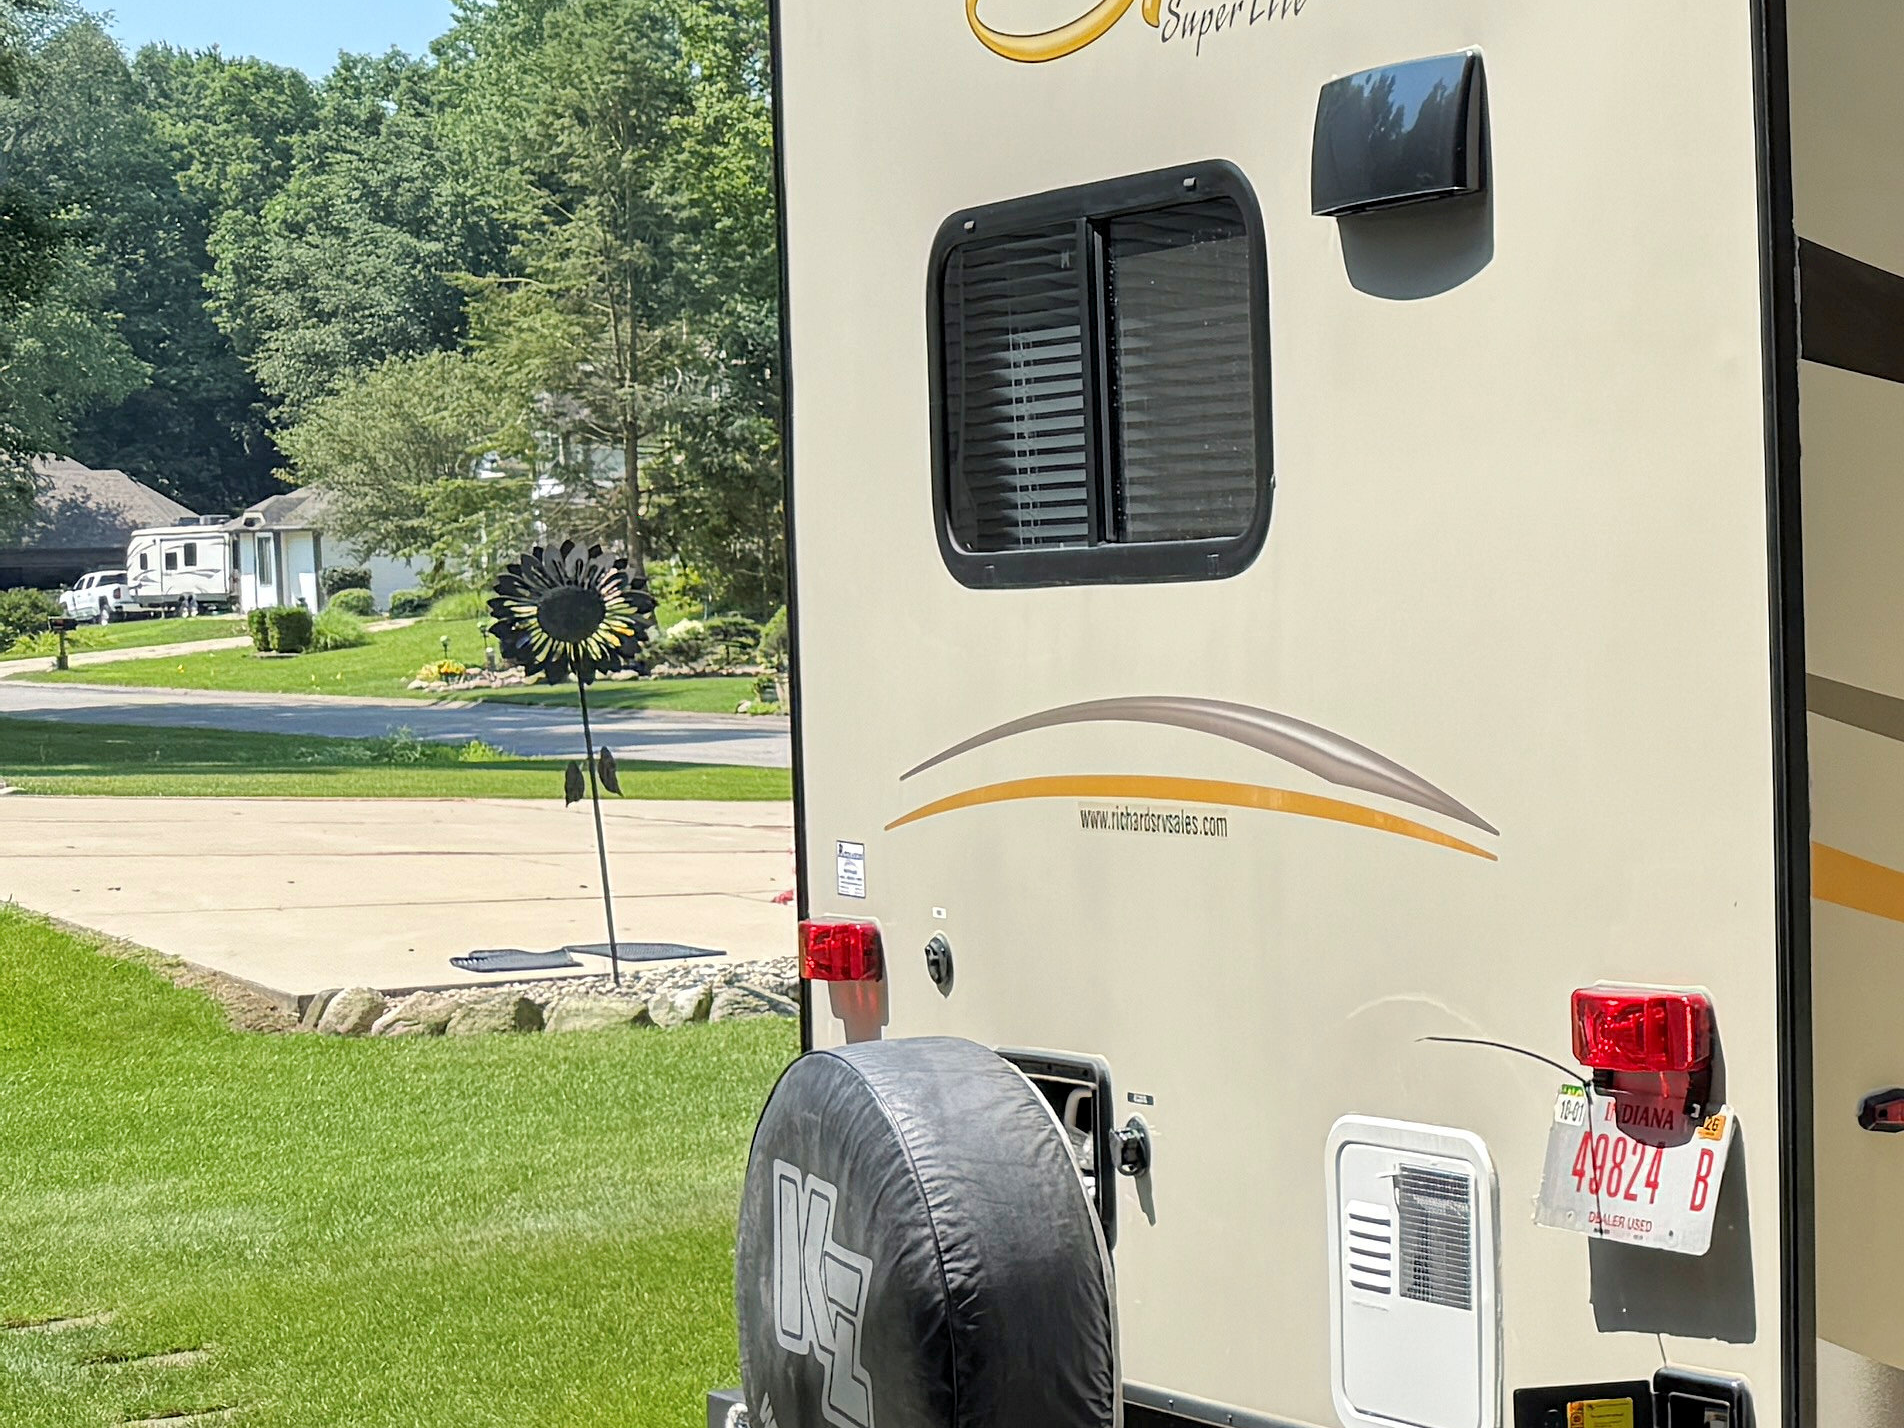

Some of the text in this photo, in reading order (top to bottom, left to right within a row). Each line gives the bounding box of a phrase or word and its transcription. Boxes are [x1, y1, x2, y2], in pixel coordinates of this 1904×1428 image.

[1080, 805, 1229, 838] www.richardsrvsales.com
[1605, 1101, 1675, 1131] INDIANA
[1689, 1148, 1714, 1212] B
[1588, 1211, 1626, 1229] DEALER
[1627, 1217, 1653, 1233] USED
